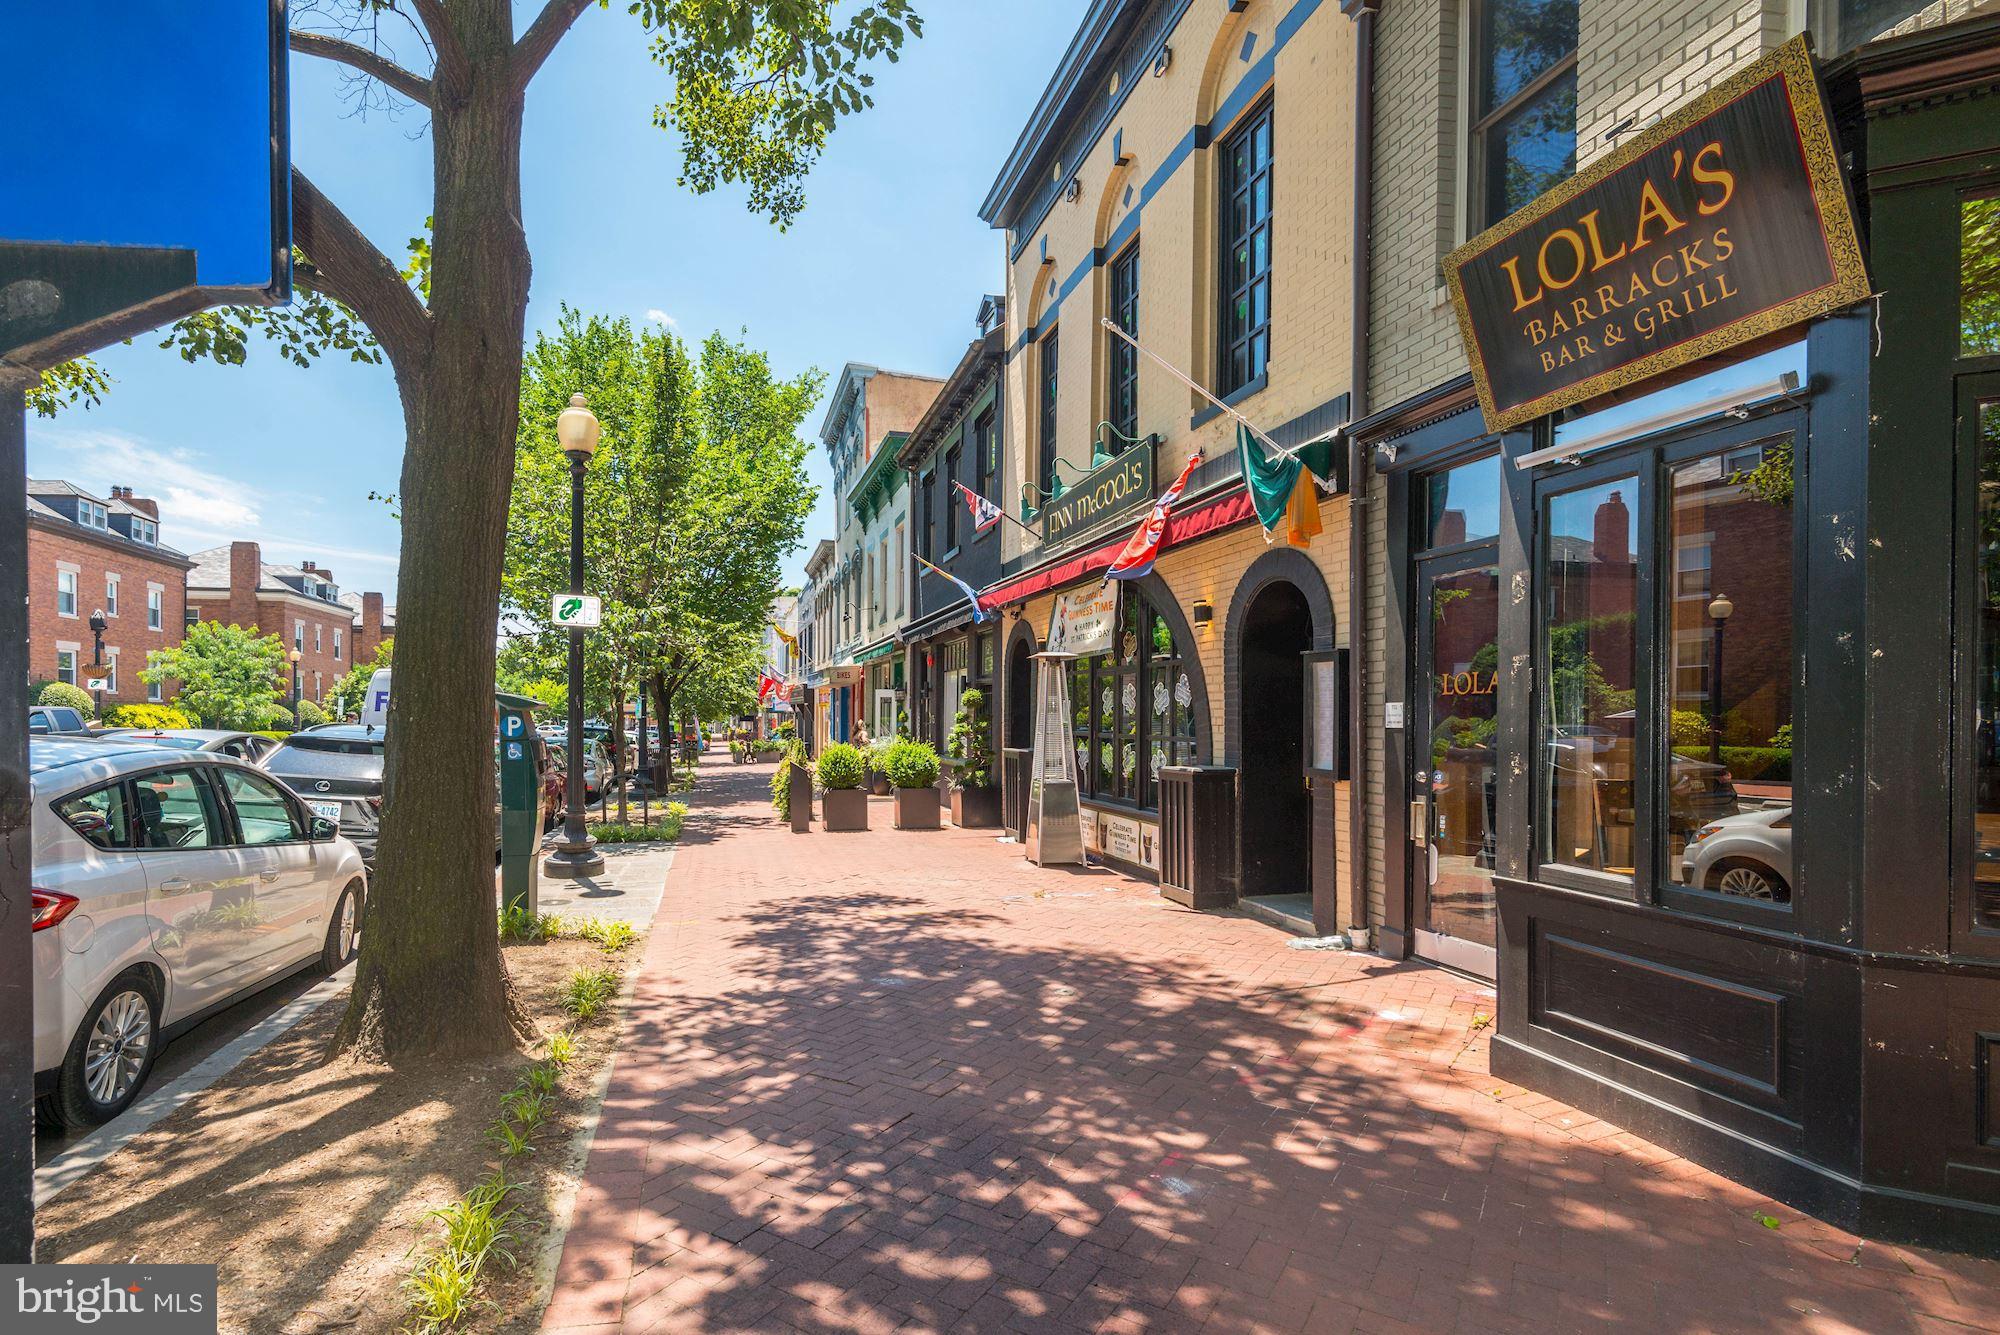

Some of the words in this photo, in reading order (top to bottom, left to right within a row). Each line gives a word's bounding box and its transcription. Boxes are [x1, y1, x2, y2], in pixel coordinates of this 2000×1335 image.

[1500, 141, 1736, 314] LOLA'S
[1523, 226, 1735, 347] BARRACKS
[1539, 335, 1597, 374] BAR
[1603, 323, 1626, 347] &
[1633, 273, 1739, 340] GRILL
[1049, 503, 1073, 540] FINN
[1093, 600, 1114, 613] TIME
[1079, 621, 1094, 631] HAPPY
[1098, 628, 1111, 638] DAY
[836, 671, 851, 679] BIKES
[507, 716, 522, 737] P
